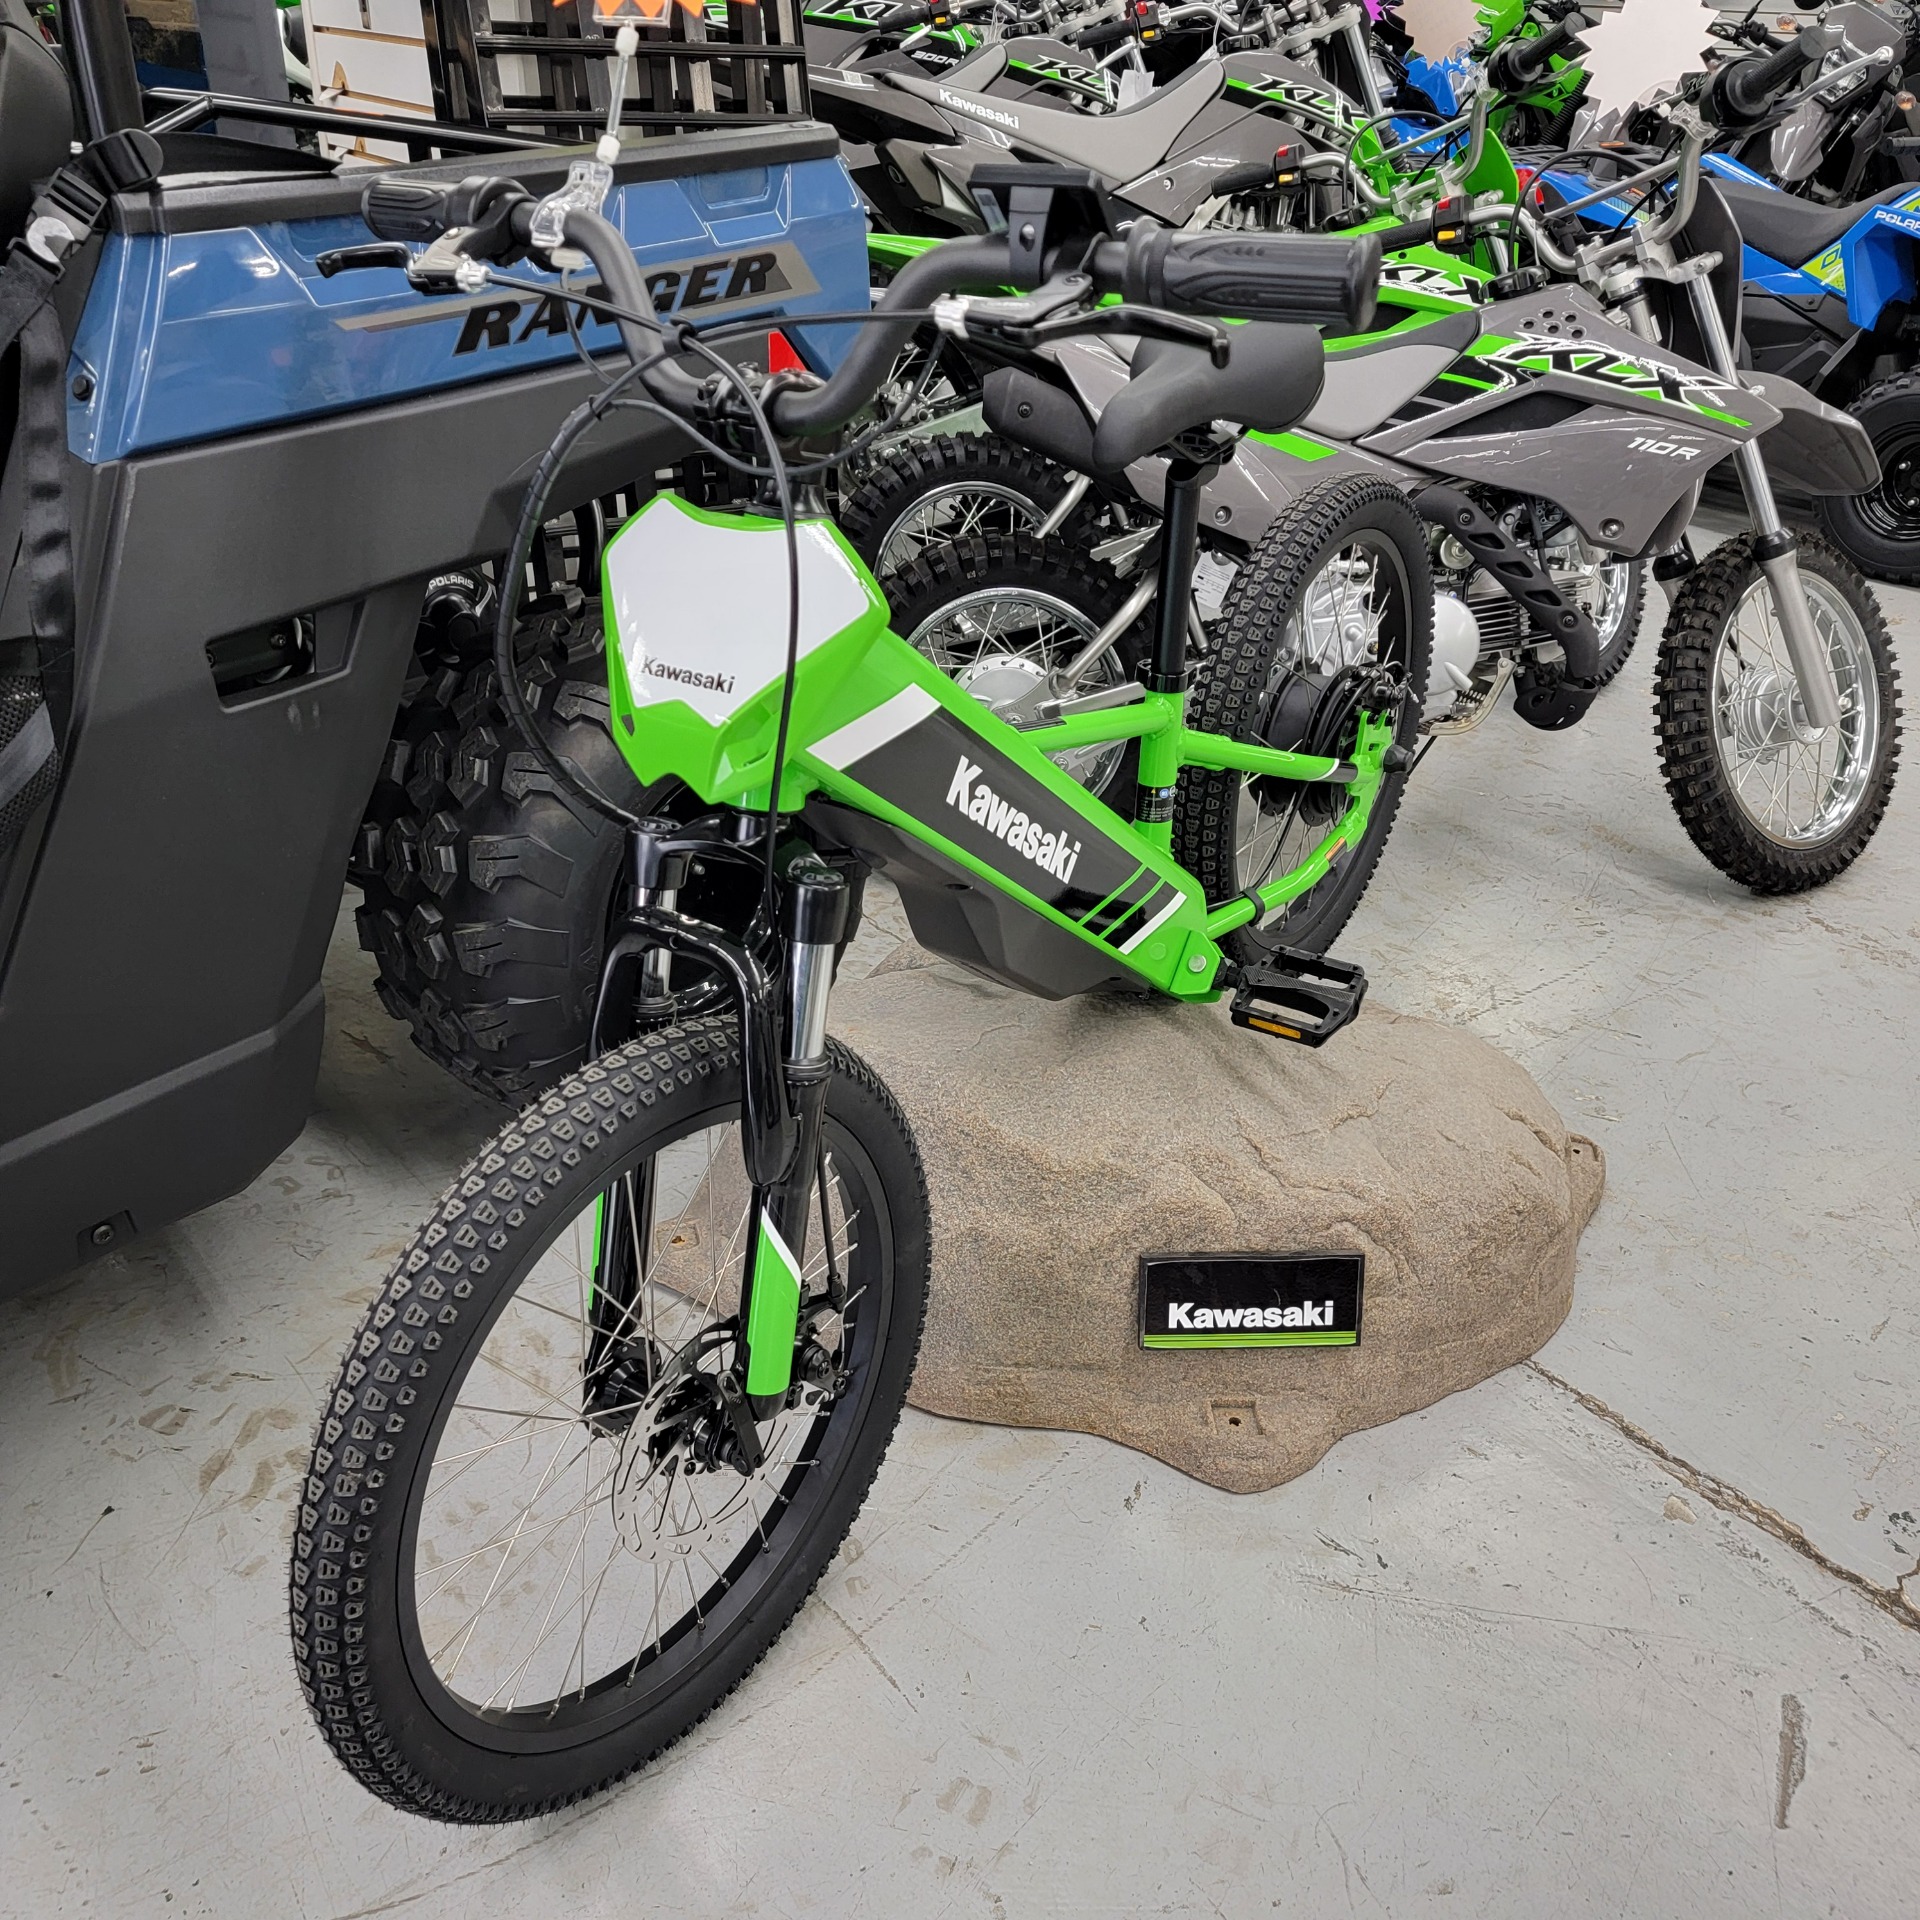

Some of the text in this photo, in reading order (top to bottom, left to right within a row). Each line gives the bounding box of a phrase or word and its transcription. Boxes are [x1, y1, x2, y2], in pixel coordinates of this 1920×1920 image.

[910, 50, 960, 67] 300R
[939, 88, 1020, 130] Kawasaki
[1626, 436, 1702, 461] 110R
[428, 575, 474, 590] POLARIS
[641, 655, 736, 694] Kawasaki
[945, 754, 1082, 885] Kawasaki
[1168, 1300, 1334, 1329] Kawasaki
